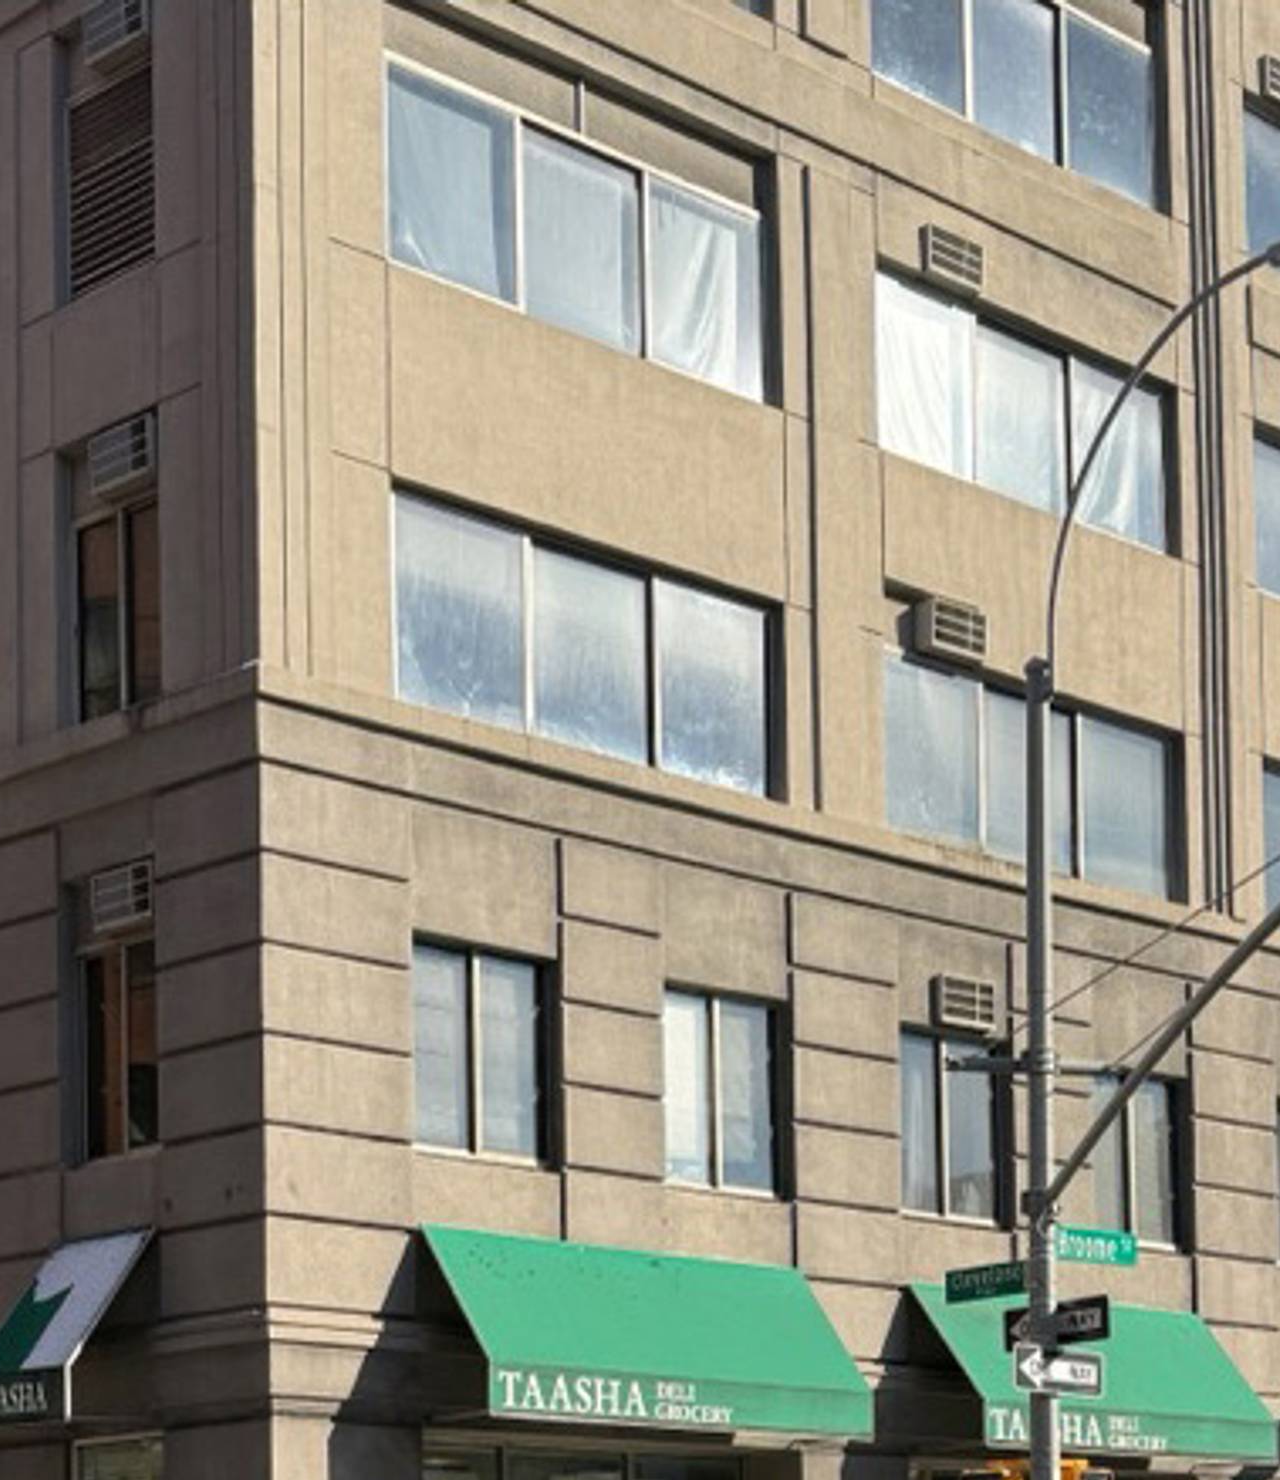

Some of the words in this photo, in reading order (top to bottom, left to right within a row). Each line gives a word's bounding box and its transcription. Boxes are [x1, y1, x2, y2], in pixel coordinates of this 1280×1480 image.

[1057, 1229, 1118, 1262] Broome
[499, 1371, 648, 1418] TAASHA
[656, 1382, 697, 1402] DELI
[654, 1402, 734, 1425] GROCERY
[989, 1407, 1103, 1447] TAHA
